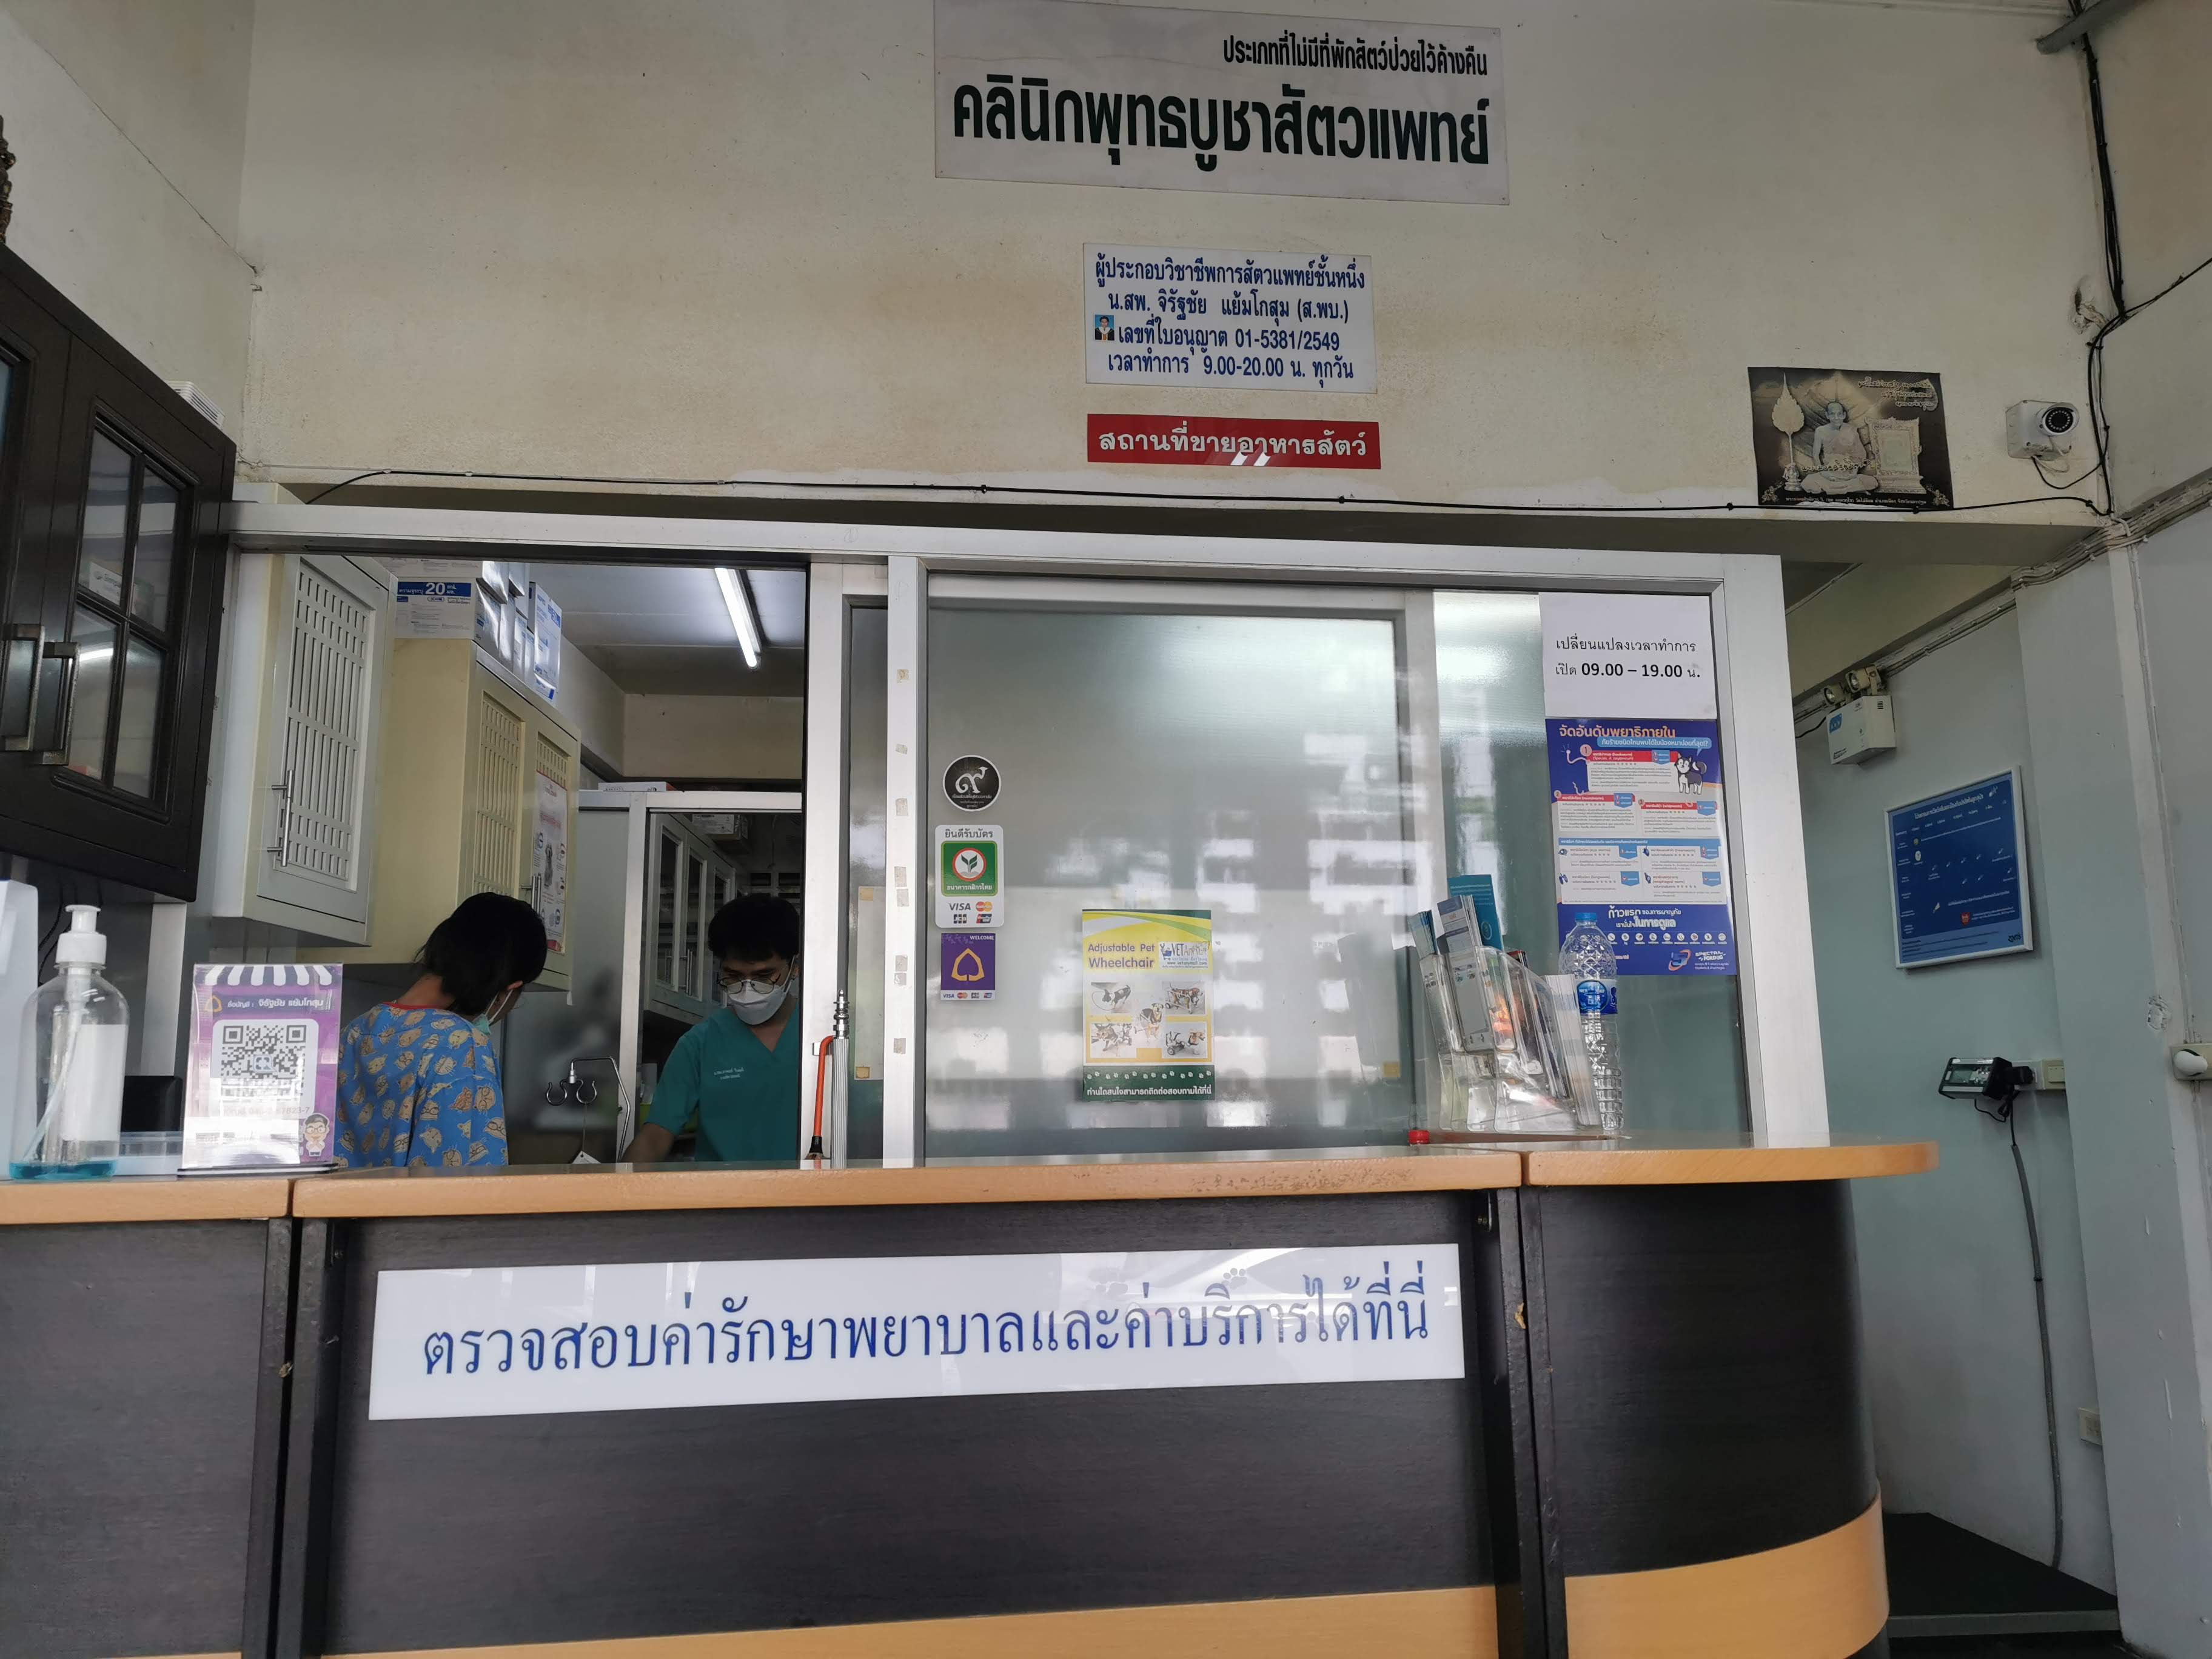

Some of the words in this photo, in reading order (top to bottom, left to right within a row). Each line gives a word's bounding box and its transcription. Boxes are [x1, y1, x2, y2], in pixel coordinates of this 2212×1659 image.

[1224, 30, 1487, 76] ประเภทที่ไม่มีที่พักสัตว์ป่วยไว้ค้างคืน
[954, 74, 1490, 172] คลินิกพุทธบูชาสัตวแพทย์
[1096, 253, 1365, 288] ผู้ประกอบวิชาชีพการสัตวแพทย์ชั้นหนึ่ง
[1108, 292, 1150, 312] น.สพ.
[1158, 289, 1207, 320] จิรัฐชัย
[1221, 289, 1290, 326] แย้มโกสุม
[1118, 313, 1228, 355] เลขที่ใบอนุญาต
[1235, 329, 1340, 351] 01-5381/2549
[1108, 348, 1189, 374] เวลาทำการ
[1204, 356, 1284, 377] 9.00-20.00
[1291, 360, 1305, 378] น.
[1312, 355, 1354, 388] ทุกวัน
[1099, 420, 1367, 456] สถานที่ขายอาหารสัตว์
[426, 582, 446, 595] 20
[1556, 632, 1696, 652] เปลี่ยนแปลงเวลาทำการ
[1555, 662, 1577, 675] เปิด
[1581, 662, 1624, 676] 09.00
[1641, 664, 1683, 677] 19.00
[1559, 724, 1676, 738] จัดอันดับพยาธิภายใน
[945, 828, 993, 838] ยินดีรับบัตร
[947, 882, 993, 891] ธนาคารกสิกรไทย
[1608, 905, 1641, 918] ก้าวแรก
[1088, 943, 1135, 954] Adjustable
[1140, 943, 1155, 952] Pet
[1089, 957, 1155, 969] Wheelchair
[423, 1260, 1429, 1375] ตรวจสอบค่ารักษาพยาบาลและค่าบริการได้ที่นี่
